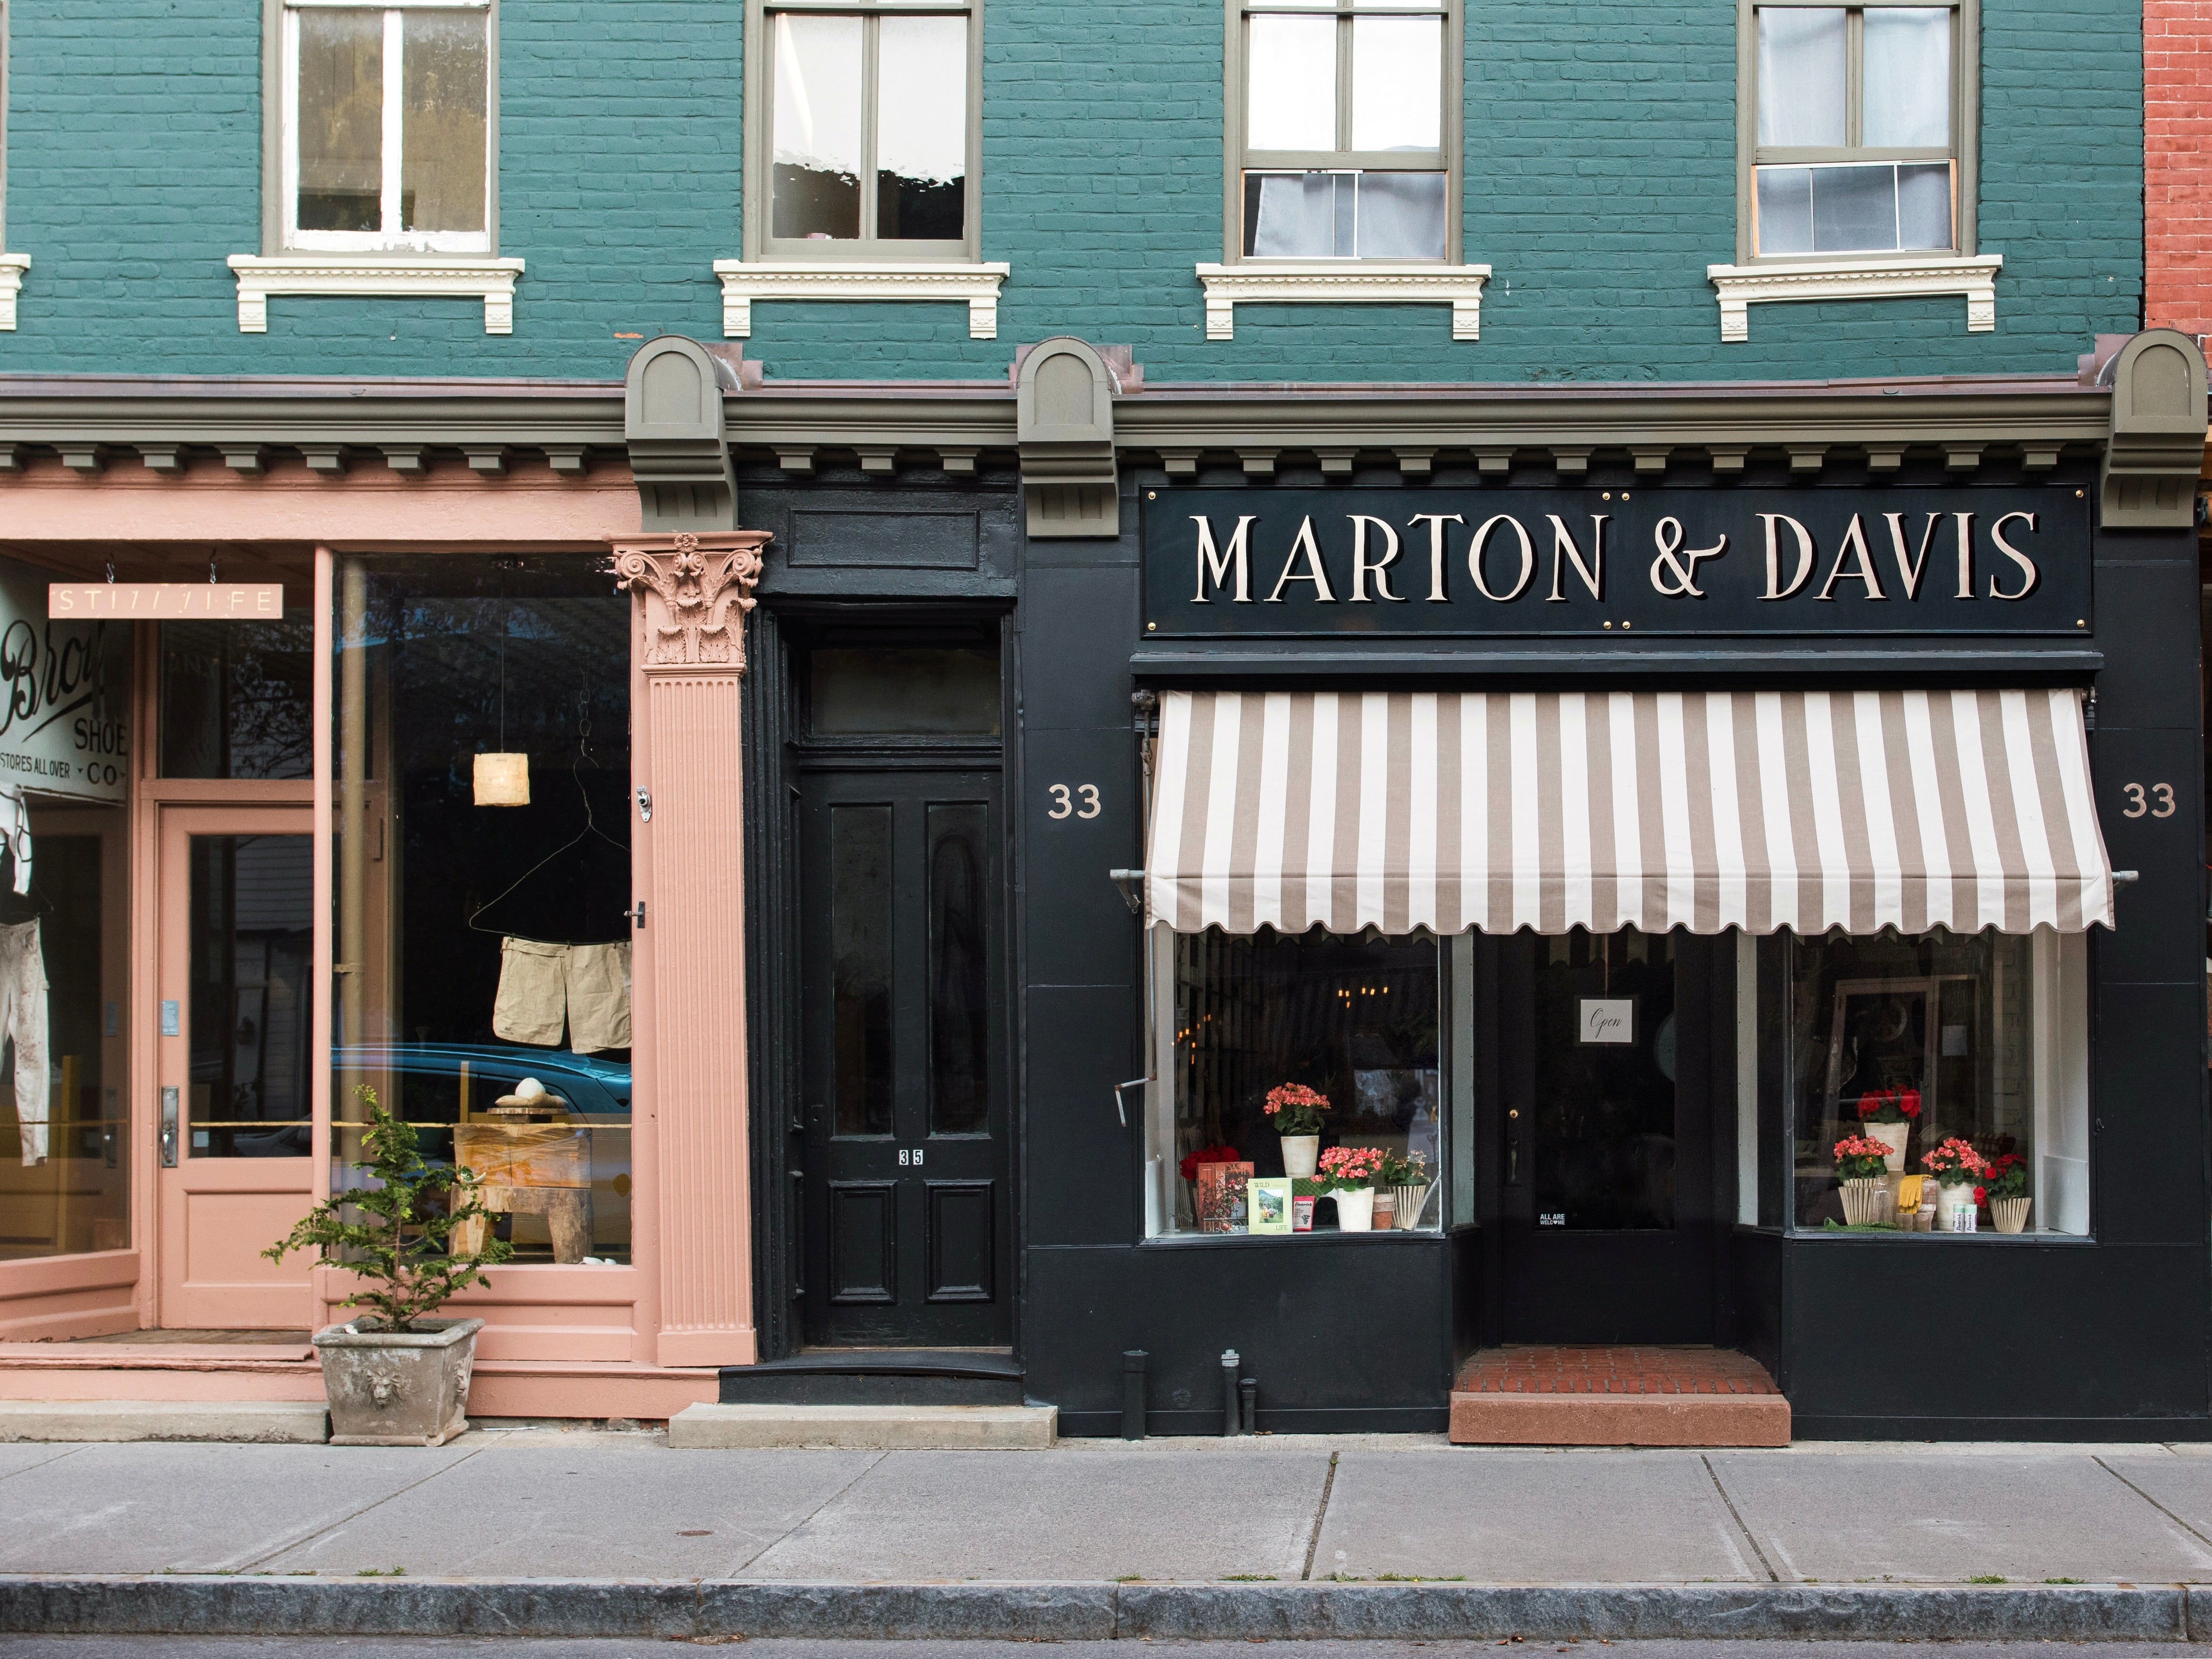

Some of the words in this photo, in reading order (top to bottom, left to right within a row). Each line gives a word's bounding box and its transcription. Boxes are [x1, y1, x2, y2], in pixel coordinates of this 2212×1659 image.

[1189, 514, 1610, 602] MARTON
[1650, 517, 1726, 596] &
[1755, 511, 2035, 600] DAVIS
[74, 718, 127, 757] SHOE
[0, 752, 32, 772] STORES
[34, 757, 48, 775] ALL
[49, 760, 70, 778] OVER
[1049, 784, 1101, 819] 33
[2123, 783, 2176, 818] 33
[1590, 1007, 1622, 1038] Open
[901, 1151, 921, 1164] 35
